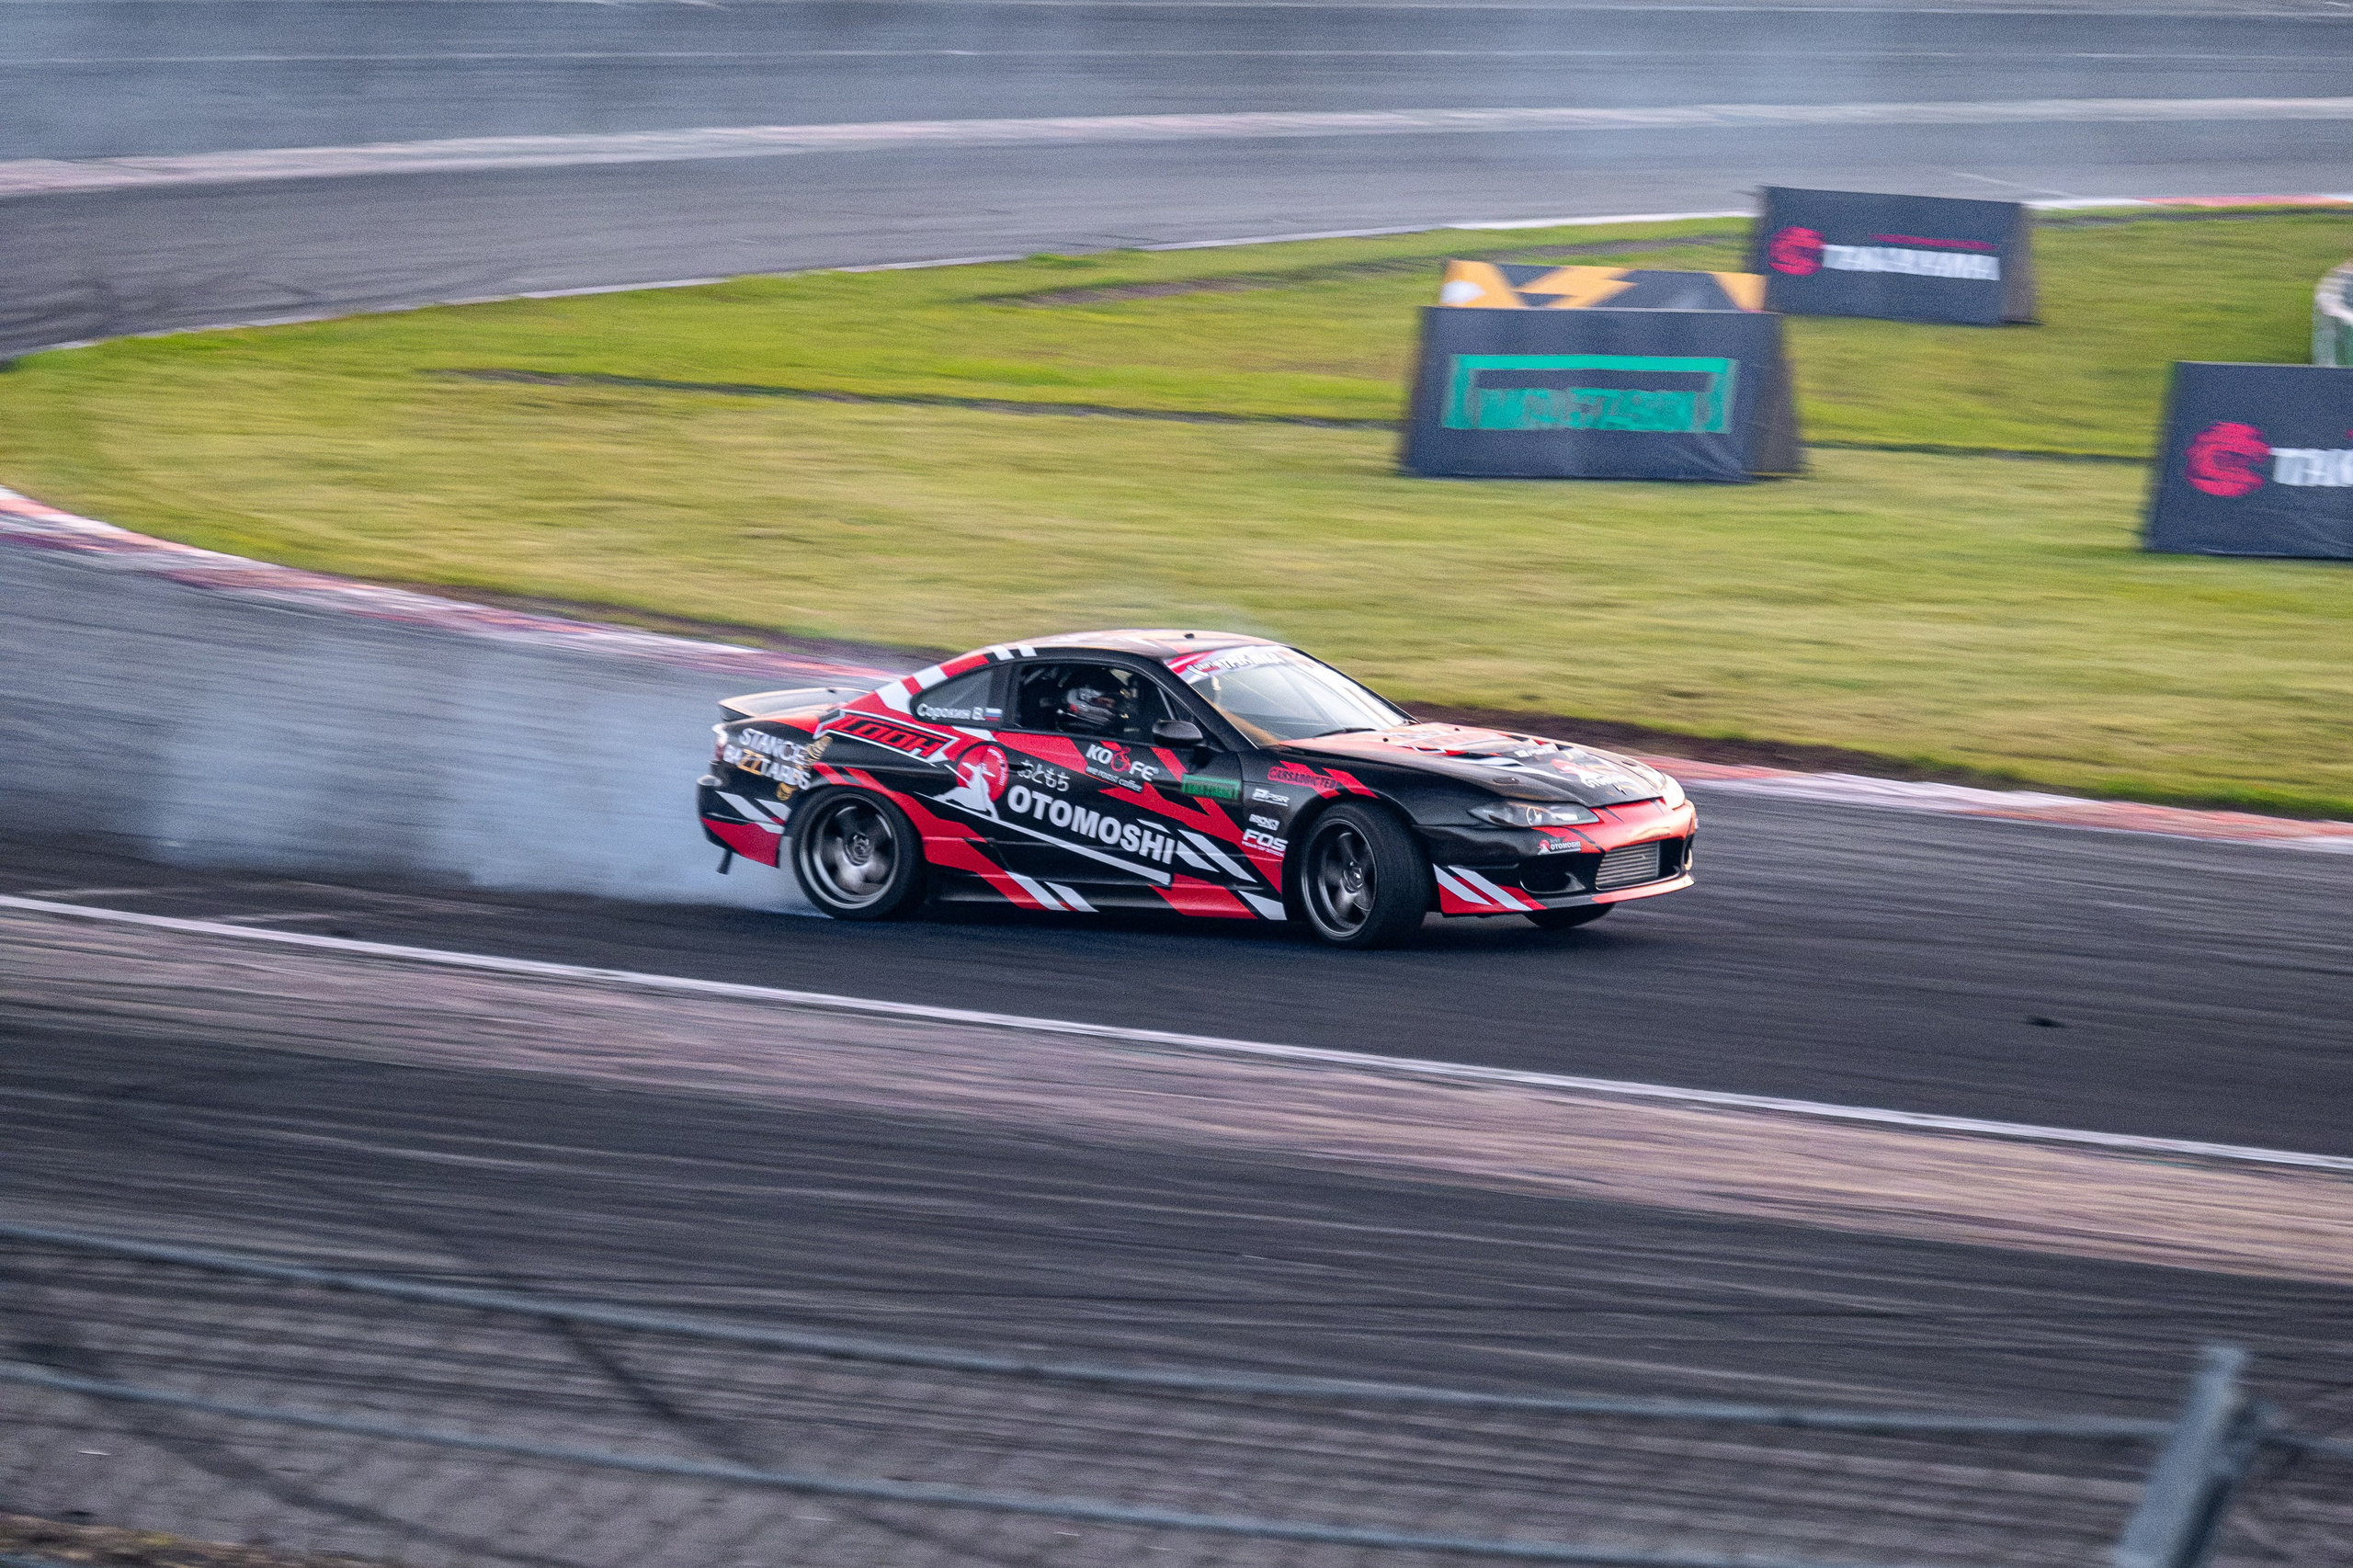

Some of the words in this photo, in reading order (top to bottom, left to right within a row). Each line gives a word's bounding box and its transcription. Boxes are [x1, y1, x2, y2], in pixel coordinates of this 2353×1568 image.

[738, 727, 811, 767] STANCE
[1007, 785, 1176, 865] OTOMOSHI
[1243, 828, 1289, 852] FOS
